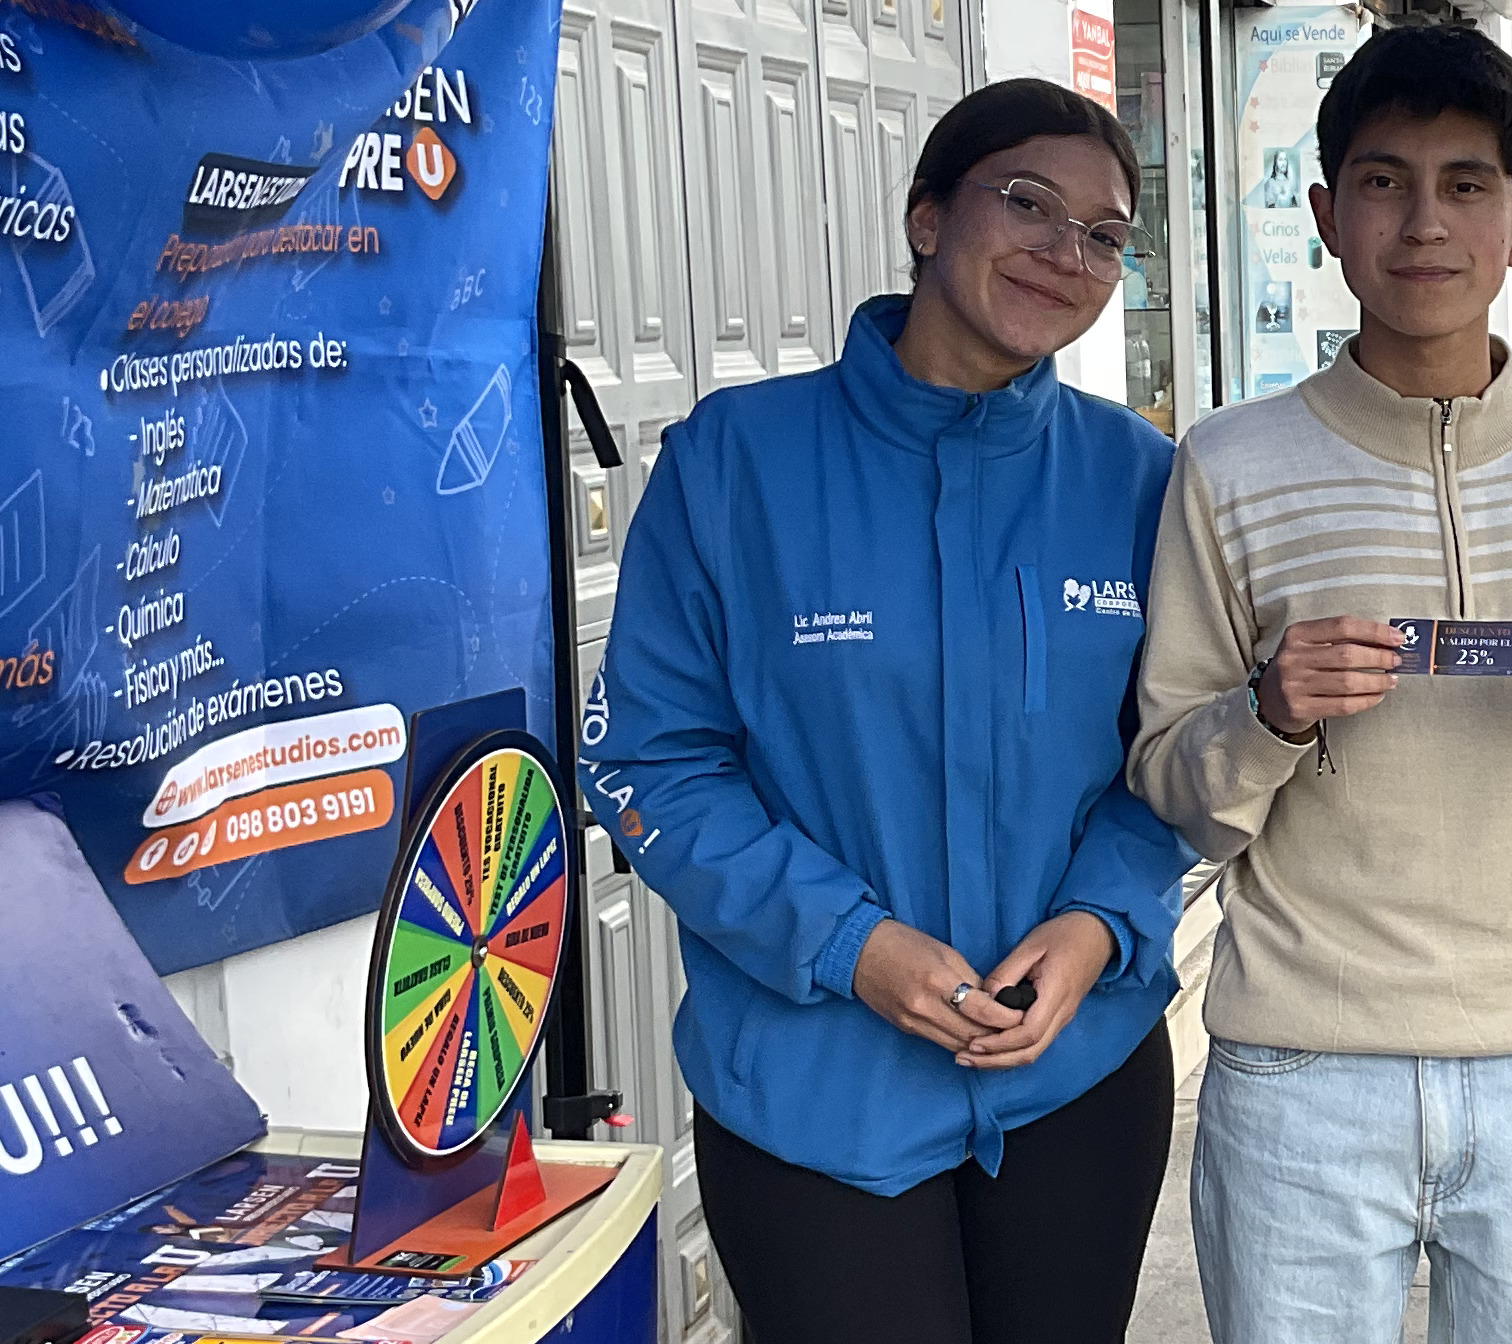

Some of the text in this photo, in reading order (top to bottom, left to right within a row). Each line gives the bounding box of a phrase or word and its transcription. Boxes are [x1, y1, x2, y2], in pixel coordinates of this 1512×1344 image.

[1286, 29, 1299, 41] se
[1301, 24, 1345, 41] Vende
[338, 132, 404, 191] PRE
[348, 223, 380, 255] en
[1262, 220, 1300, 237] Cirios
[1263, 248, 1298, 264] Velas
[110, 332, 347, 396] Clases personalizadas de:
[141, 407, 185, 466] Inglés
[136, 459, 222, 520] Matemática
[126, 528, 180, 581] Cálculo
[118, 589, 184, 648] Química
[812, 611, 846, 627] Andrea
[849, 611, 873, 624] Abril
[1479, 637, 1498, 646] POR
[1500, 638, 1512, 647] EL
[1456, 649, 1495, 666] 25%
[67, 668, 343, 770] Resolución de exámenes
[178, 724, 400, 808] www.larsenestudios.com
[226, 787, 376, 844] 098 803 9191
[494, 783, 505, 852] GRATUITO
[509, 813, 532, 880] GRATUITO
[215, 1184, 285, 1221] LARSEN
